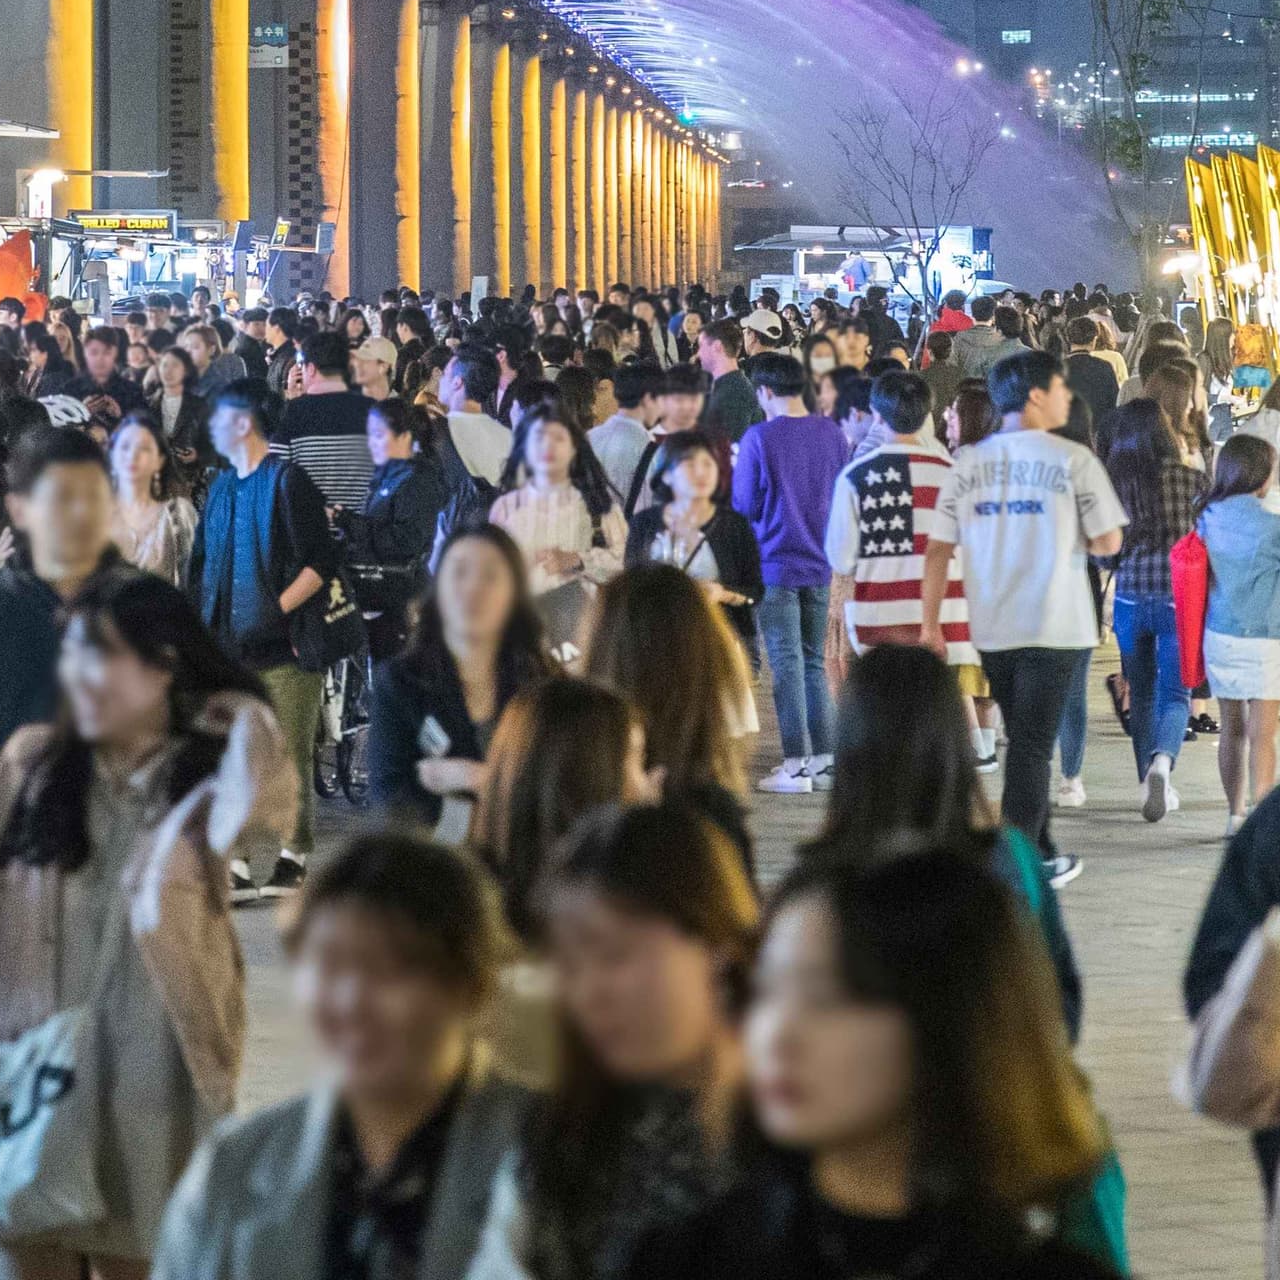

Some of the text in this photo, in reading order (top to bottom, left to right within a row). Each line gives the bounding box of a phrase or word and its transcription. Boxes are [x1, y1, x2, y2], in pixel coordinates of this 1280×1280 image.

[126, 218, 169, 229] CUBAN
[974, 500, 1045, 516] NEW YORK
